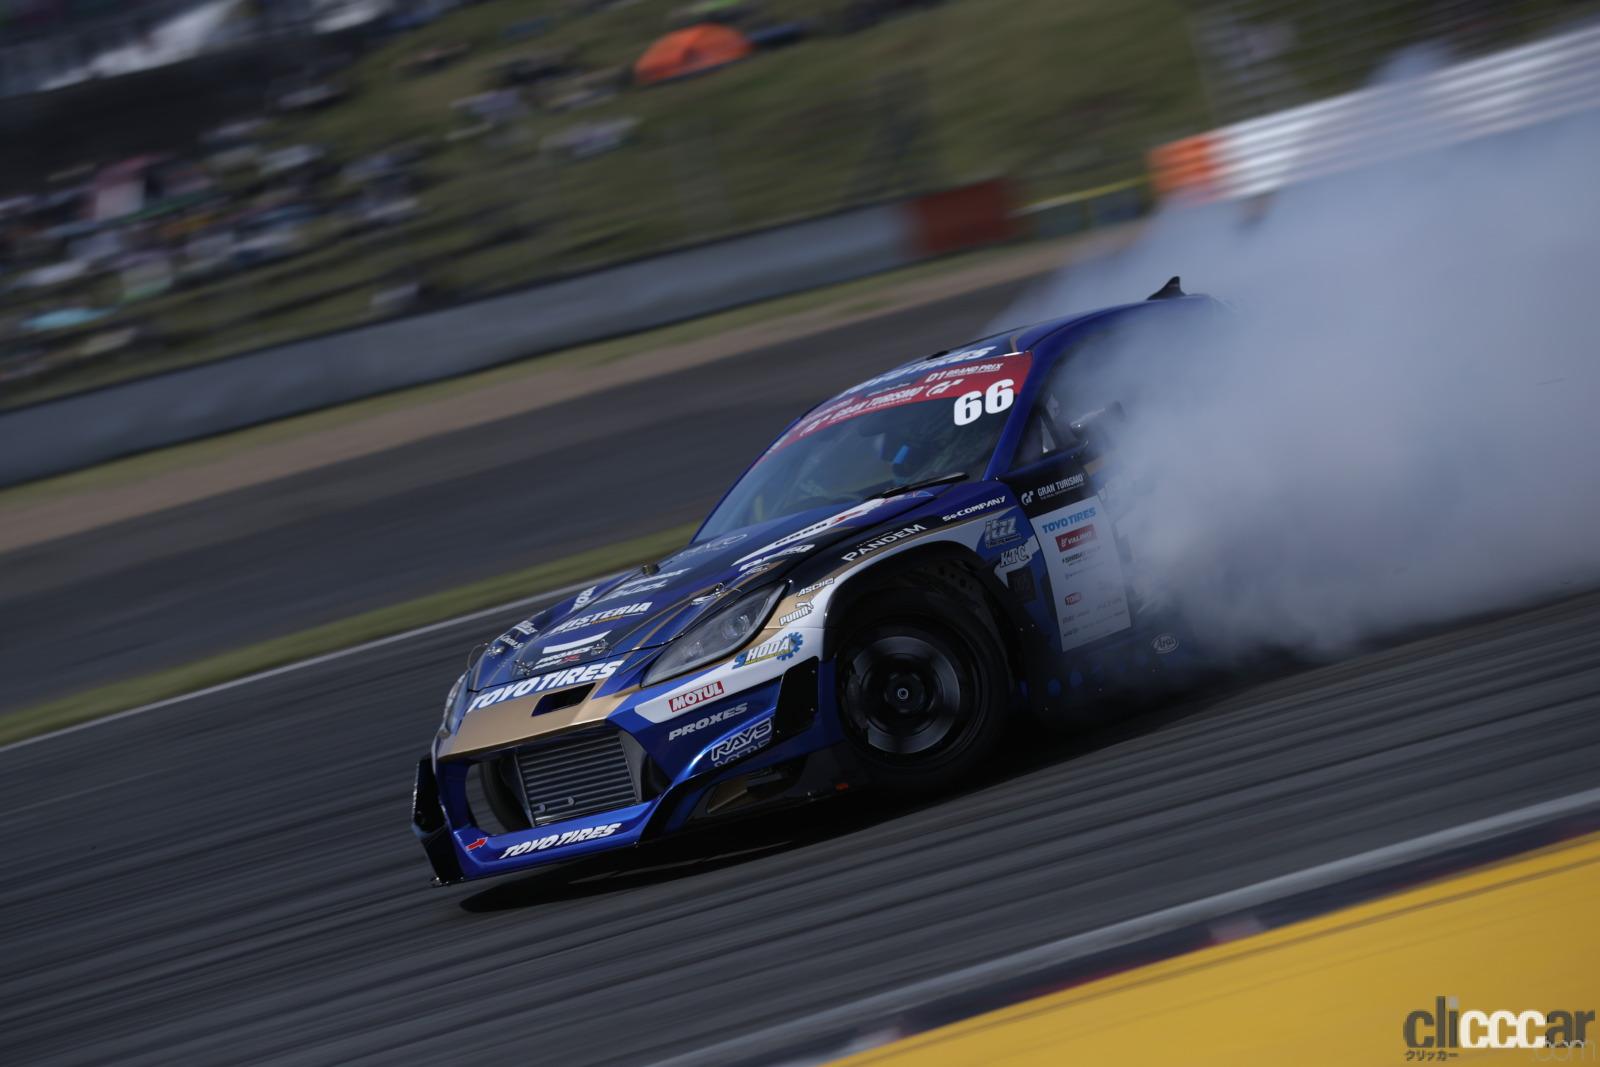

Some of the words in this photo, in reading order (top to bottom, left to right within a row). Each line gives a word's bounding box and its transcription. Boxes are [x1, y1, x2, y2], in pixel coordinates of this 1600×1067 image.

[924, 371, 946, 383] D1
[977, 363, 1004, 374] PRIX
[953, 378, 1014, 426] 66
[1037, 482, 1056, 497] GRAN
[1055, 473, 1085, 490] TURISMO
[1041, 515, 1070, 535] TOYO
[1067, 507, 1097, 528] TIRES
[841, 524, 928, 562] PANDEM
[1000, 545, 1027, 568] KTC
[779, 605, 813, 627] PUMA
[467, 677, 540, 713] TOYO
[538, 660, 625, 688] TIRES
[672, 681, 724, 712] MOTUL
[668, 702, 748, 741] PROXES
[711, 717, 772, 761] RAYS
[499, 835, 560, 859] TOYO
[554, 823, 622, 847] TIRES
